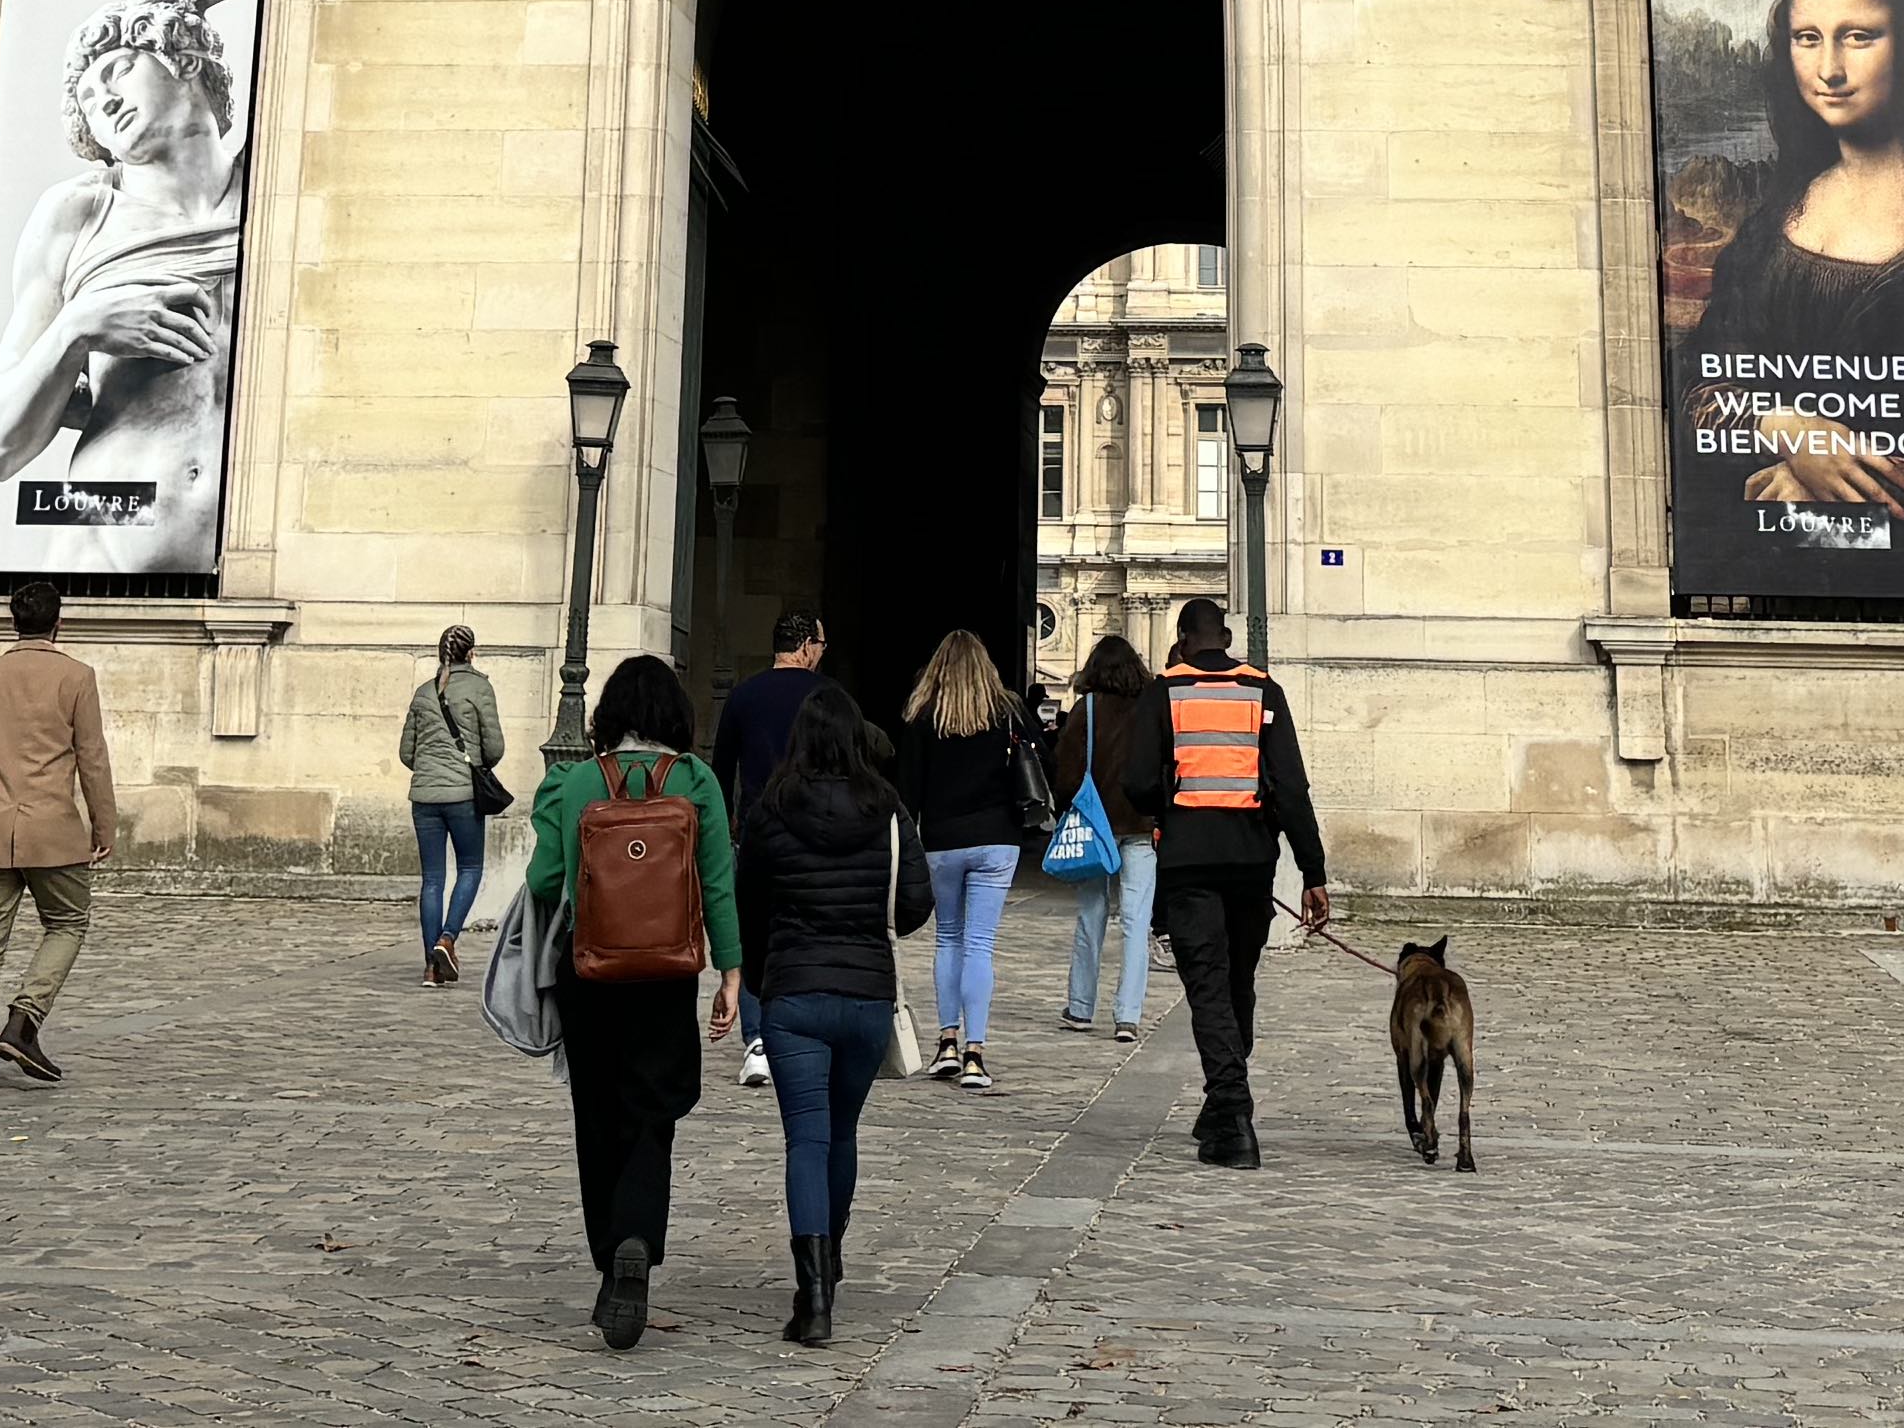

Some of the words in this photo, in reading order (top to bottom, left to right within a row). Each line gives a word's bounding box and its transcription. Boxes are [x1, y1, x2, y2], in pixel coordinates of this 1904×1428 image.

[1714, 391, 1902, 419] WELCOME
[33, 489, 141, 512] LOUVRE
[1757, 509, 1873, 534] LOUVRE
[1328, 551, 1336, 564] 2
